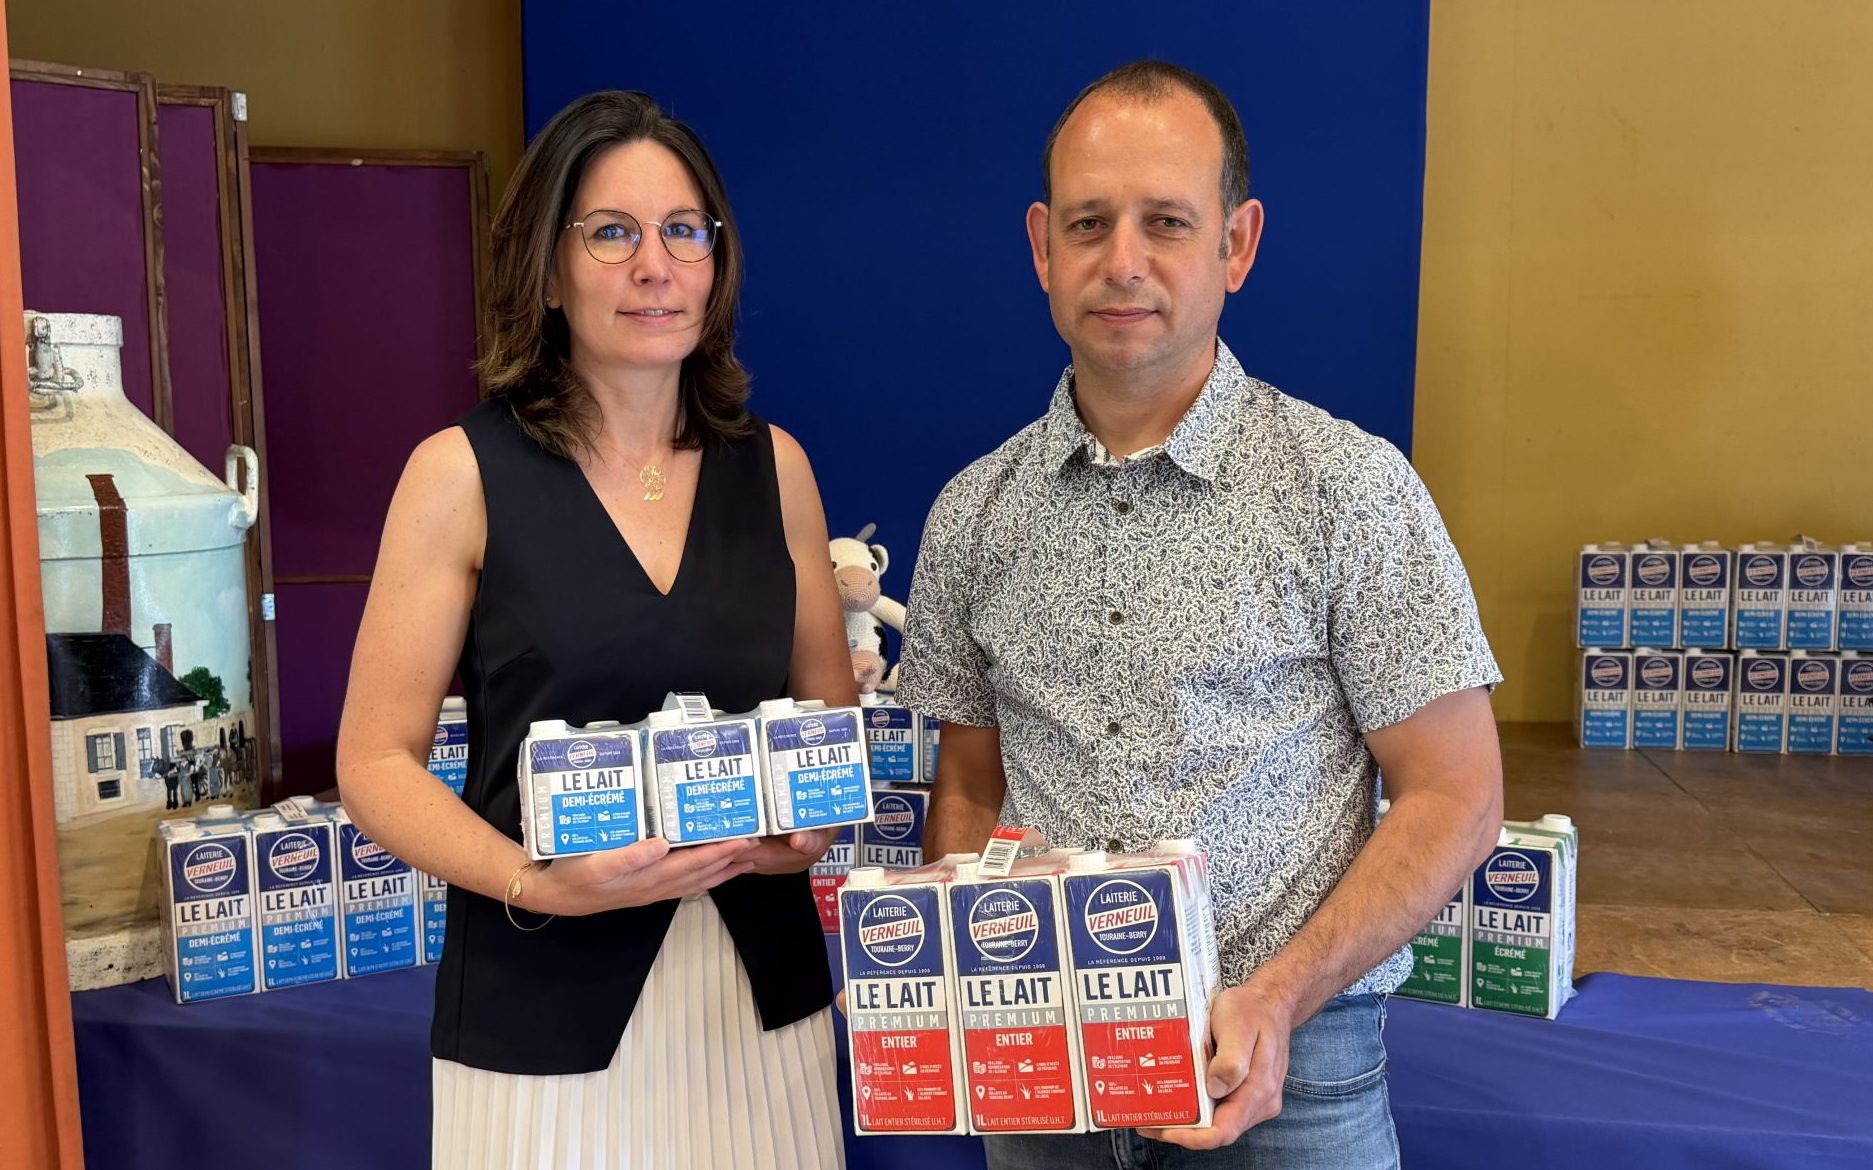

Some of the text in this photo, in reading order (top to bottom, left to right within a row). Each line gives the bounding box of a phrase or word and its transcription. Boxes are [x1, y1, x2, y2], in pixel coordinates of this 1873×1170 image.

[1584, 590, 1621, 600] LE LAIT
[1634, 590, 1671, 600] LE LAIT
[1685, 590, 1722, 600] LE LAIT
[1742, 592, 1778, 601] LE LAIT
[1792, 592, 1828, 602] LE LAIT
[1844, 592, 1873, 602] LE LA
[1588, 692, 1624, 701] LE LAIT
[1638, 692, 1674, 702] LE LAIT
[1688, 694, 1725, 703] LE LAIT
[1743, 695, 1780, 706] LE LAIT
[1793, 696, 1830, 707] LE LAIT
[1843, 697, 1873, 707] LE LA
[882, 731, 905, 741] LAIT
[441, 746, 466, 759] LAIT
[797, 746, 851, 768] LE LAIT
[429, 761, 466, 771] EMI-ÉCRÉMÉ
[685, 758, 742, 780] LE LAIT
[562, 770, 623, 791] LE LAIT
[798, 767, 854, 784] DEMI-ÉCRÉMÉ
[686, 778, 745, 796] DEMI-ÉCRÉMÉ
[562, 791, 625, 808] DEMI-ÉCRÉMÉ
[196, 850, 222, 861] LAITERIE
[272, 848, 317, 867] VERNEUIL
[868, 847, 918, 865] LE LAIT
[187, 858, 234, 878] VERNEUIL
[814, 866, 850, 875] EMIUM
[1499, 859, 1526, 870] LAITERIE
[1488, 872, 1537, 883] VERNEUIL
[349, 877, 406, 900] LE LAIT
[266, 887, 327, 911] LE LAIT
[350, 895, 408, 913] PREMIUM
[1101, 891, 1138, 904] LAITERIE
[181, 898, 244, 923] LE LAIT
[873, 906, 907, 918] LAITERIE
[984, 901, 1020, 913] LAITERIE
[356, 908, 403, 924] DEMI-ÉCRÉMÉ
[1089, 904, 1156, 931] VERNEUIL
[1479, 909, 1544, 933] LE LAIT
[862, 919, 922, 943] VERNEUIL
[973, 914, 1036, 939] VERNEUIL
[189, 932, 241, 948] DEMI-ÉCRÉMÉ
[1099, 931, 1148, 941] TOURAINE-BERRY
[1478, 931, 1544, 948] PREMIUM
[1495, 946, 1526, 960] ÉCRÉMÉ
[1084, 969, 1173, 1000] LE LAIT
[856, 981, 936, 1009] LE LAIT
[967, 977, 1052, 1007] LE LAIT
[1475, 996, 1483, 1005] 1L
[970, 1010, 1056, 1028] PREMIUM
[1088, 1004, 1178, 1021] PREMIUM
[857, 1014, 940, 1029] PREMIUM
[996, 1032, 1033, 1046] ENTIER
[1115, 1026, 1155, 1040] ENTIER
[881, 1036, 917, 1048] ENTIER
[862, 1114, 872, 1126] 1L
[885, 1118, 904, 1126] ENTIER
[976, 1114, 987, 1126] 1L
[987, 1117, 999, 1126] LAIT
[1001, 1117, 1020, 1126] ENTIER
[1097, 1110, 1107, 1122] 1L
[1108, 1113, 1120, 1122] LAIT
[1122, 1112, 1142, 1121] ENTIER
